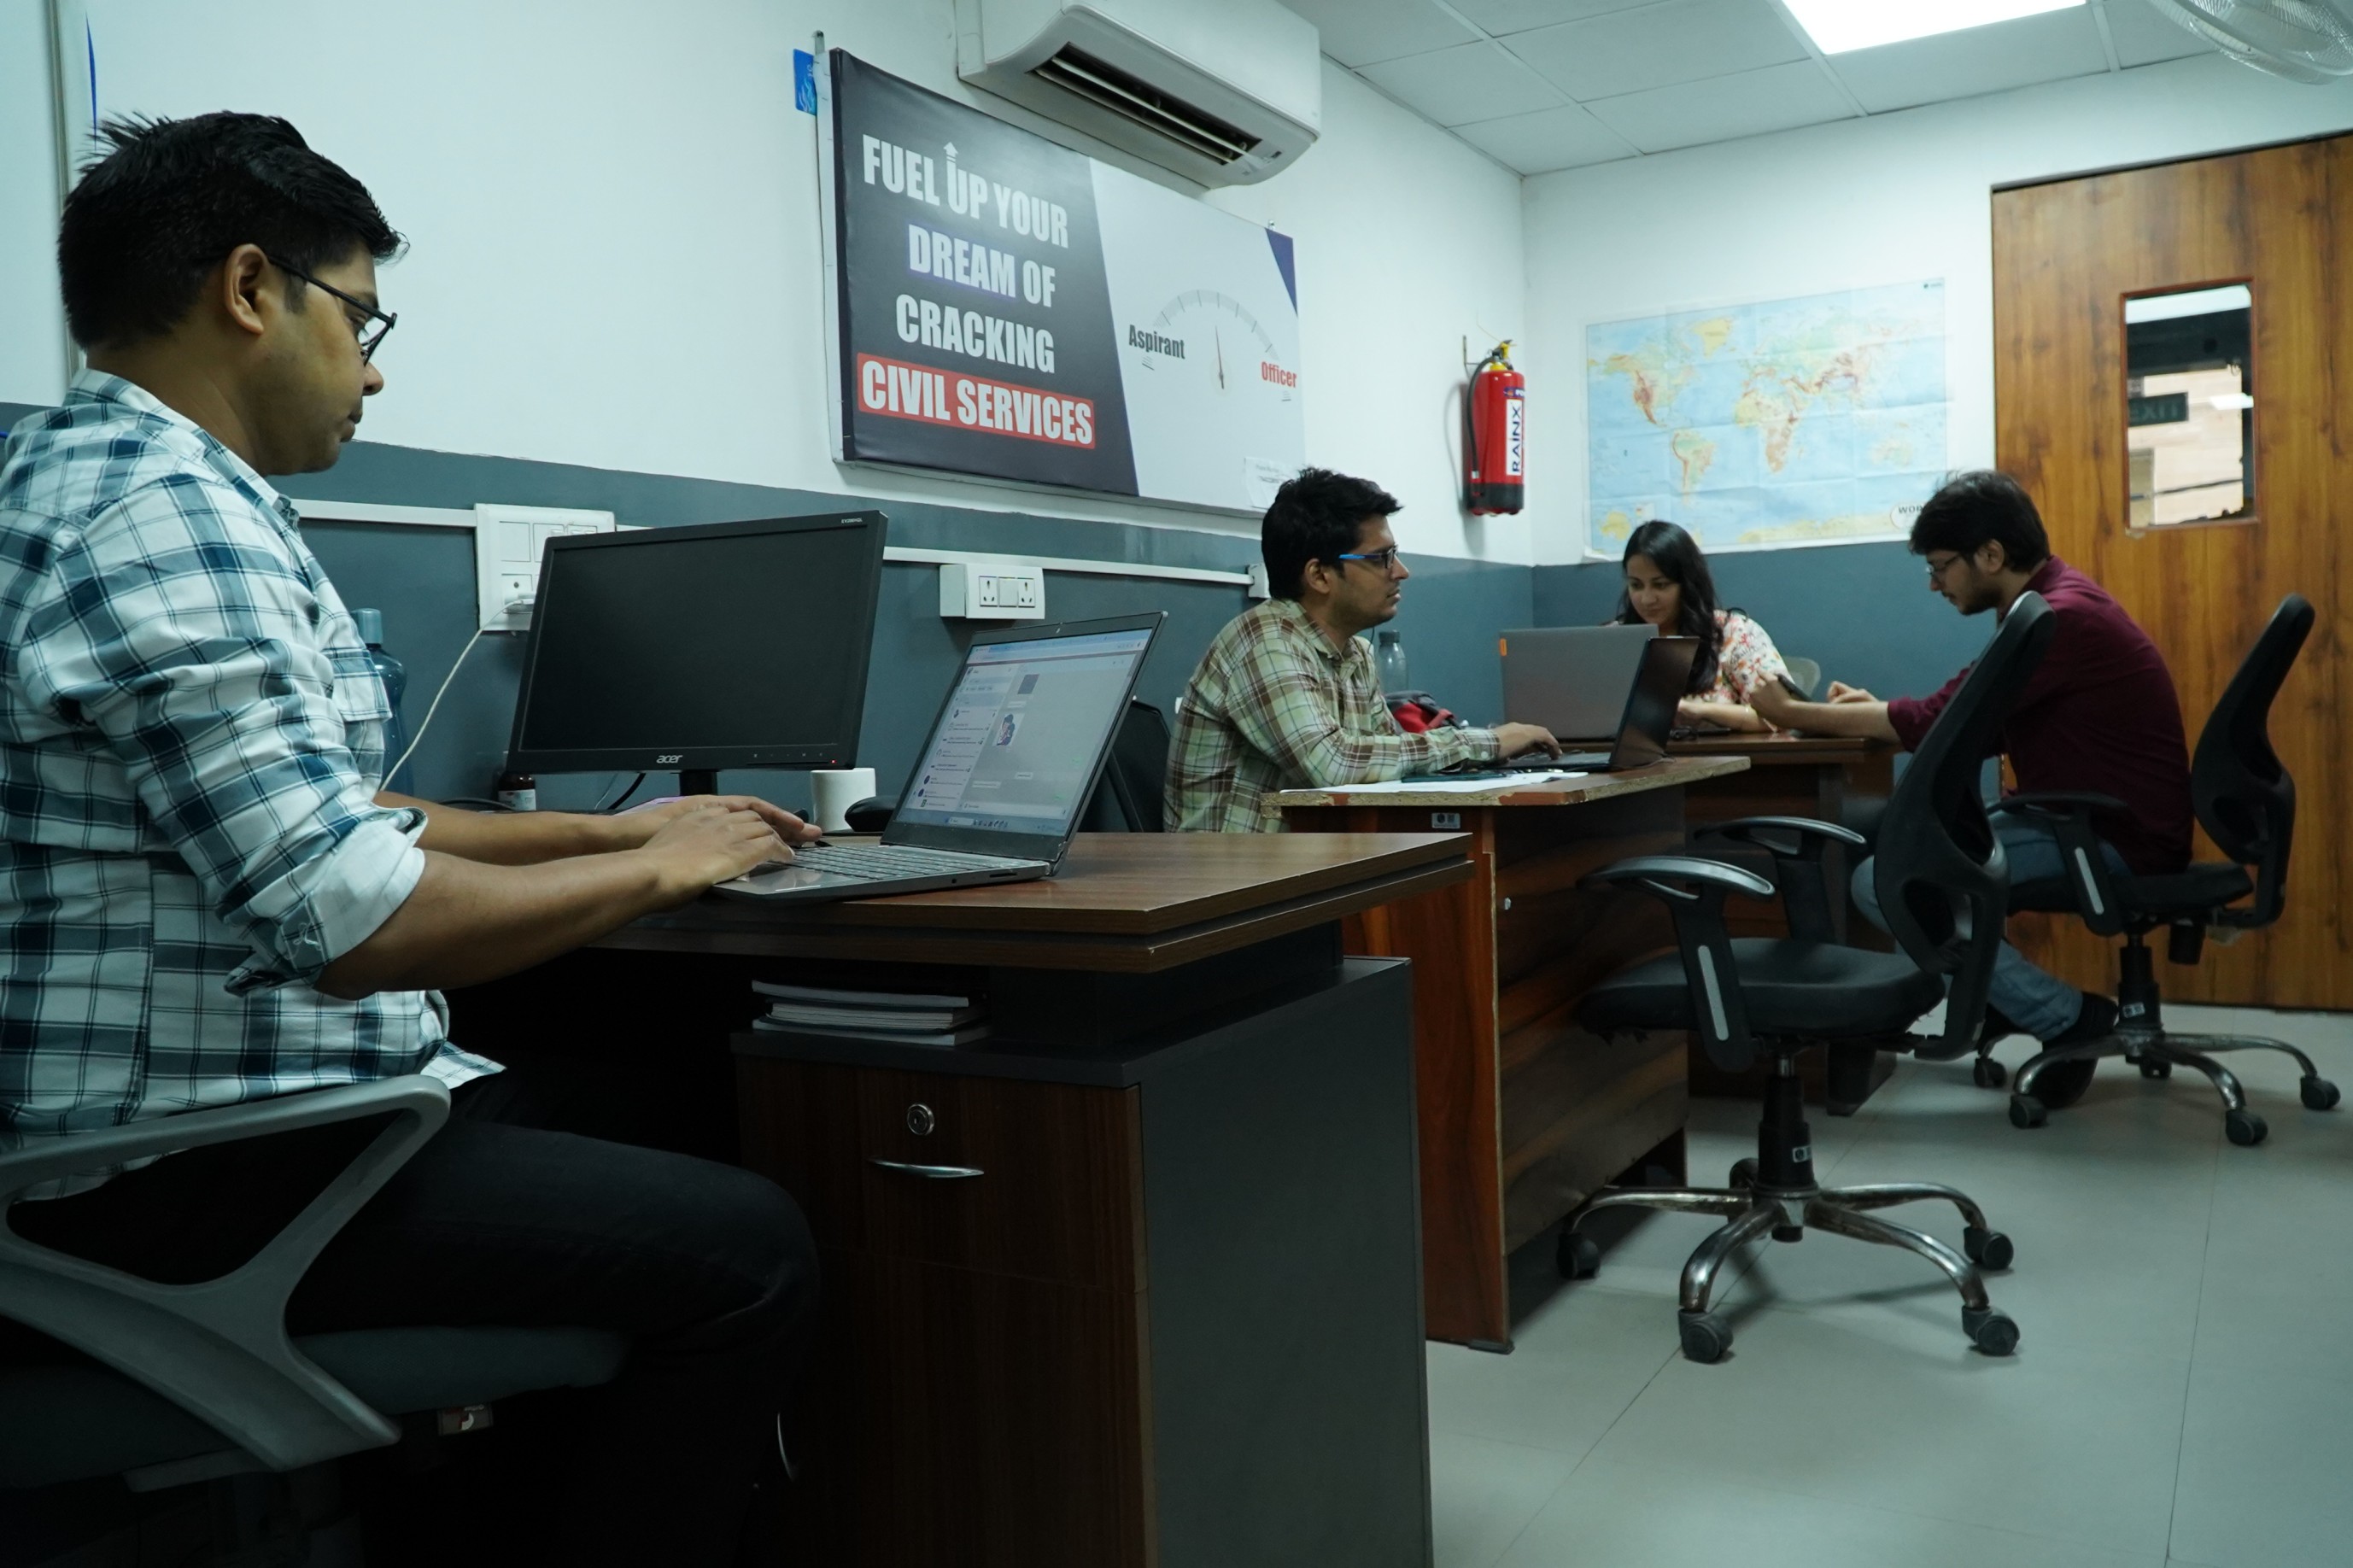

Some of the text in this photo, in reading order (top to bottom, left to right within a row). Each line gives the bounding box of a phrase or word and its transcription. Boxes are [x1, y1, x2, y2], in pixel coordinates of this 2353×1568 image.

[863, 134, 1068, 249] FUEL UP YOUR
[909, 224, 1056, 307] DREAM OF
[896, 294, 1055, 373] CRACKING
[1128, 324, 1185, 360] Aspirant
[862, 360, 1093, 445] CIVIL SERVICES
[1261, 360, 1297, 389] Officer
[1512, 406, 1520, 472] RAINX
[656, 754, 683, 764] acer
